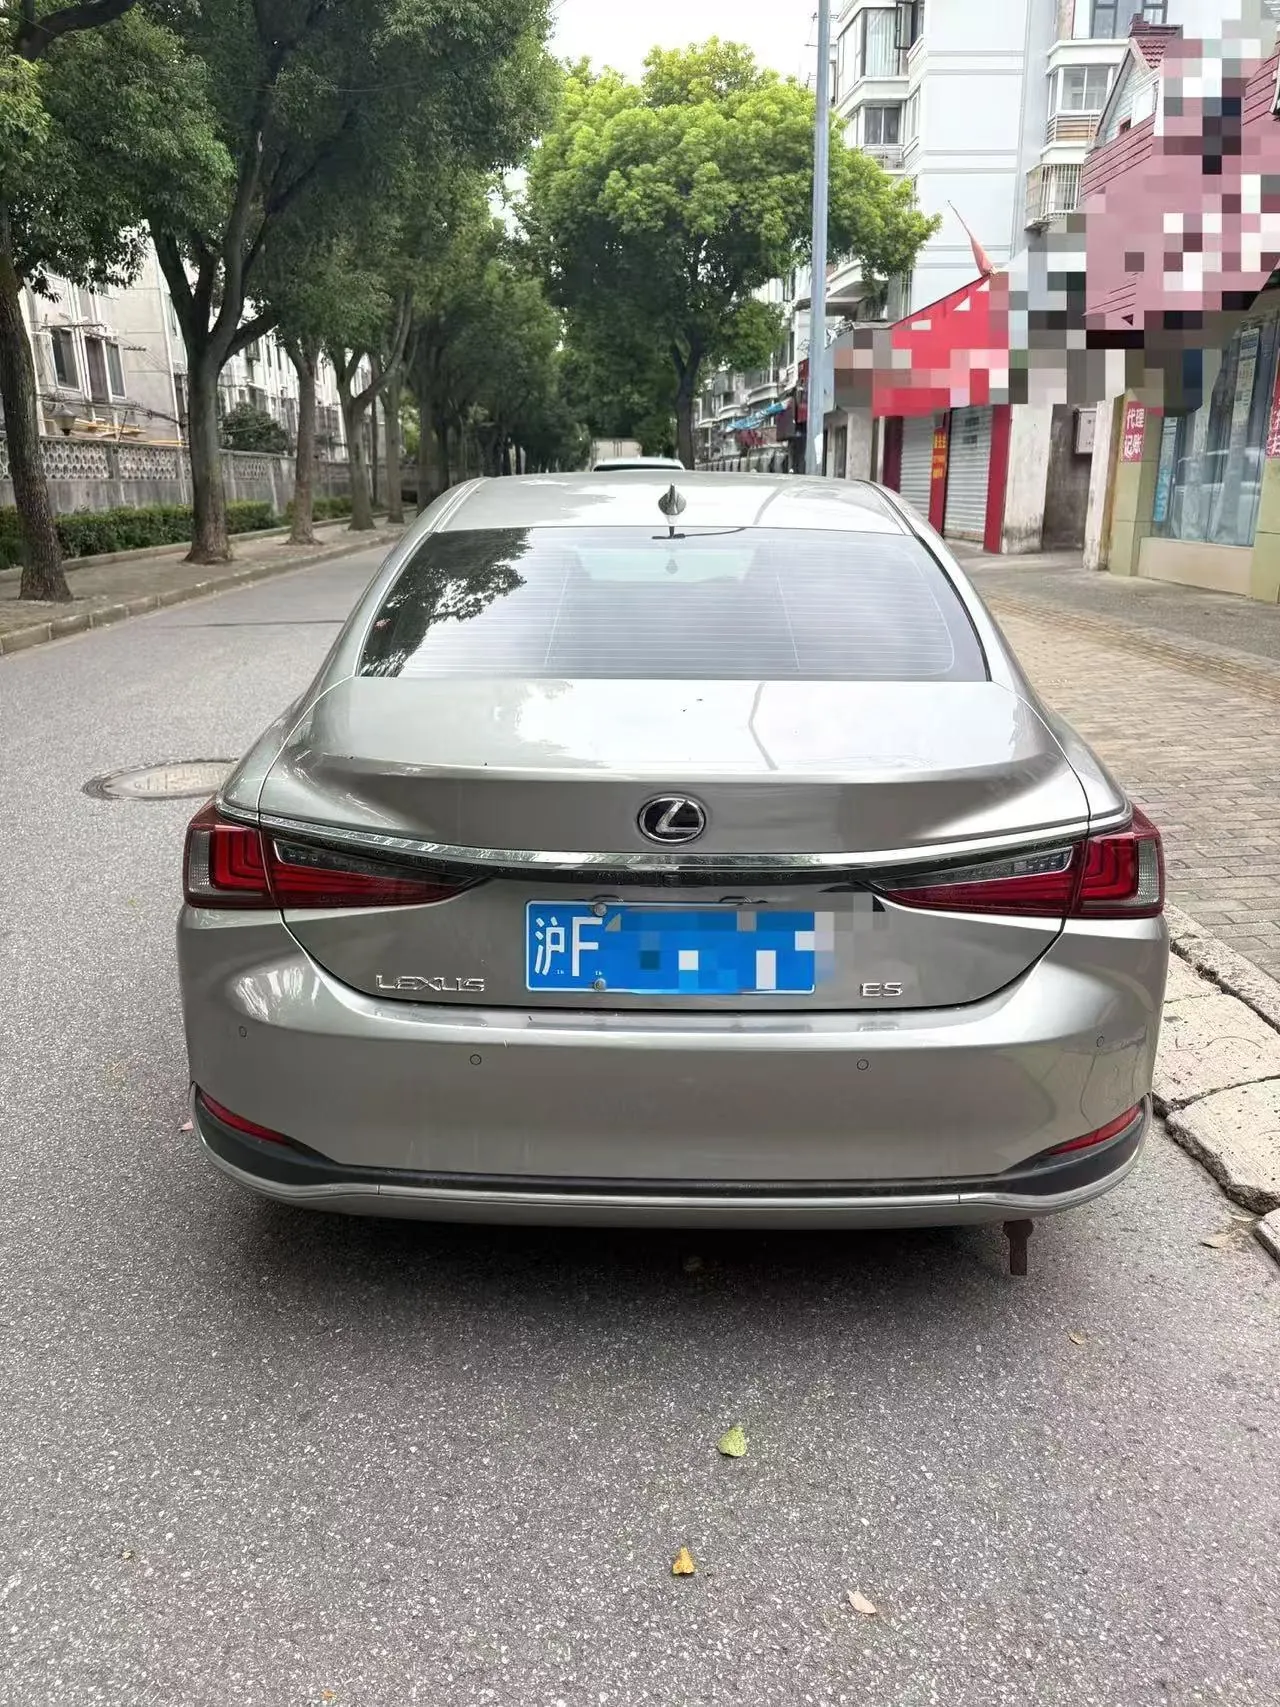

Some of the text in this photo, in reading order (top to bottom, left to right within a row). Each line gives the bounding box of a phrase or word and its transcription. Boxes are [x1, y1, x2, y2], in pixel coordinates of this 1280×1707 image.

[1127, 408, 1144, 429] 代理
[376, 975, 485, 992] LEXUS
[861, 982, 903, 997] ES
